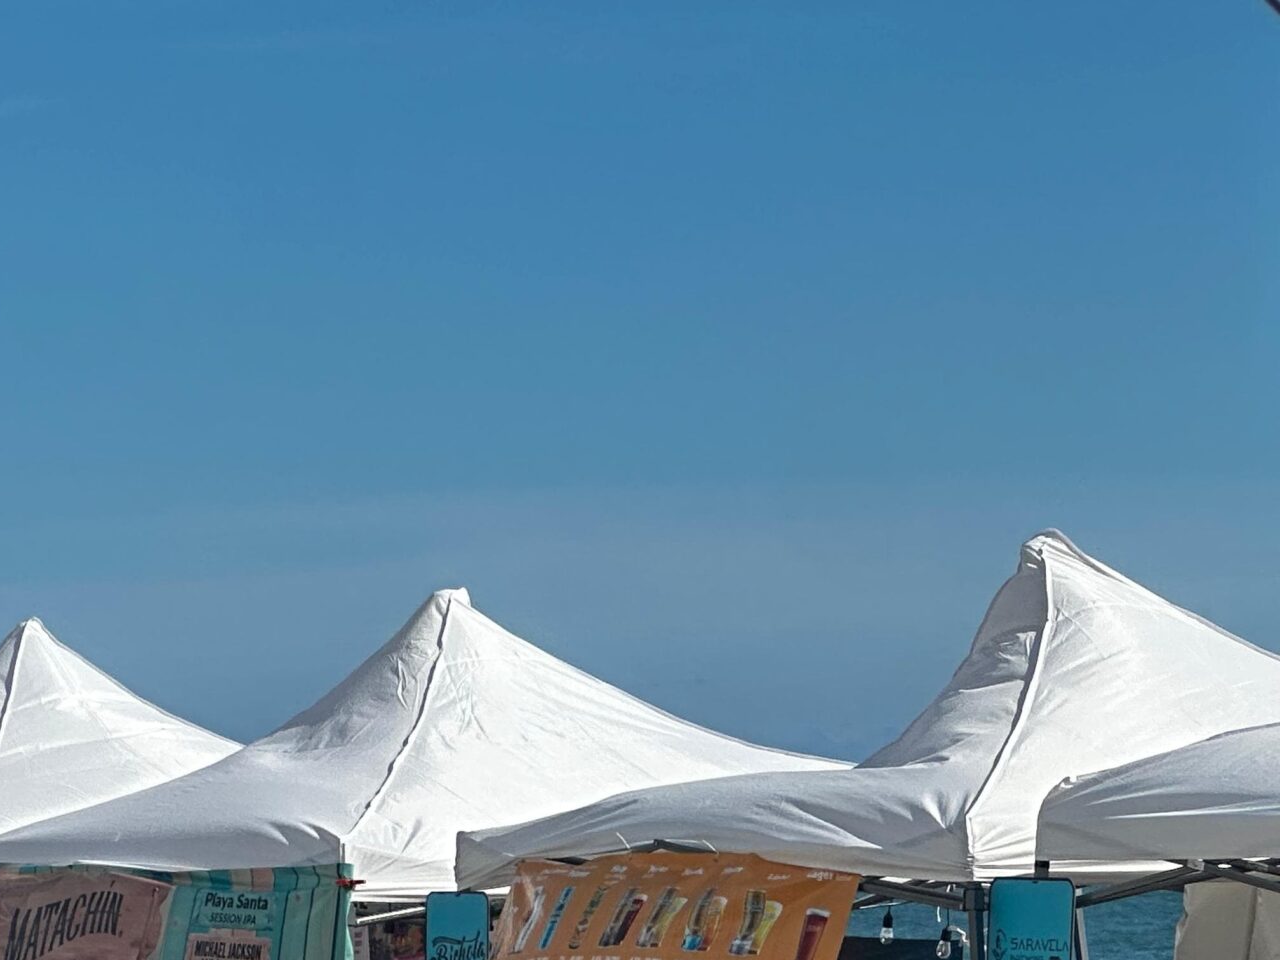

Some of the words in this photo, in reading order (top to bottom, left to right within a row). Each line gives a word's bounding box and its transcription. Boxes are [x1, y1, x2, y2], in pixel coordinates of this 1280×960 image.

[204, 892, 234, 911] Playa
[236, 893, 269, 911] Santa
[210, 912, 241, 924] SESSION
[243, 914, 257, 925] IPA
[193, 940, 226, 960] MICHAEL
[1009, 937, 1069, 953] SARAVELA
